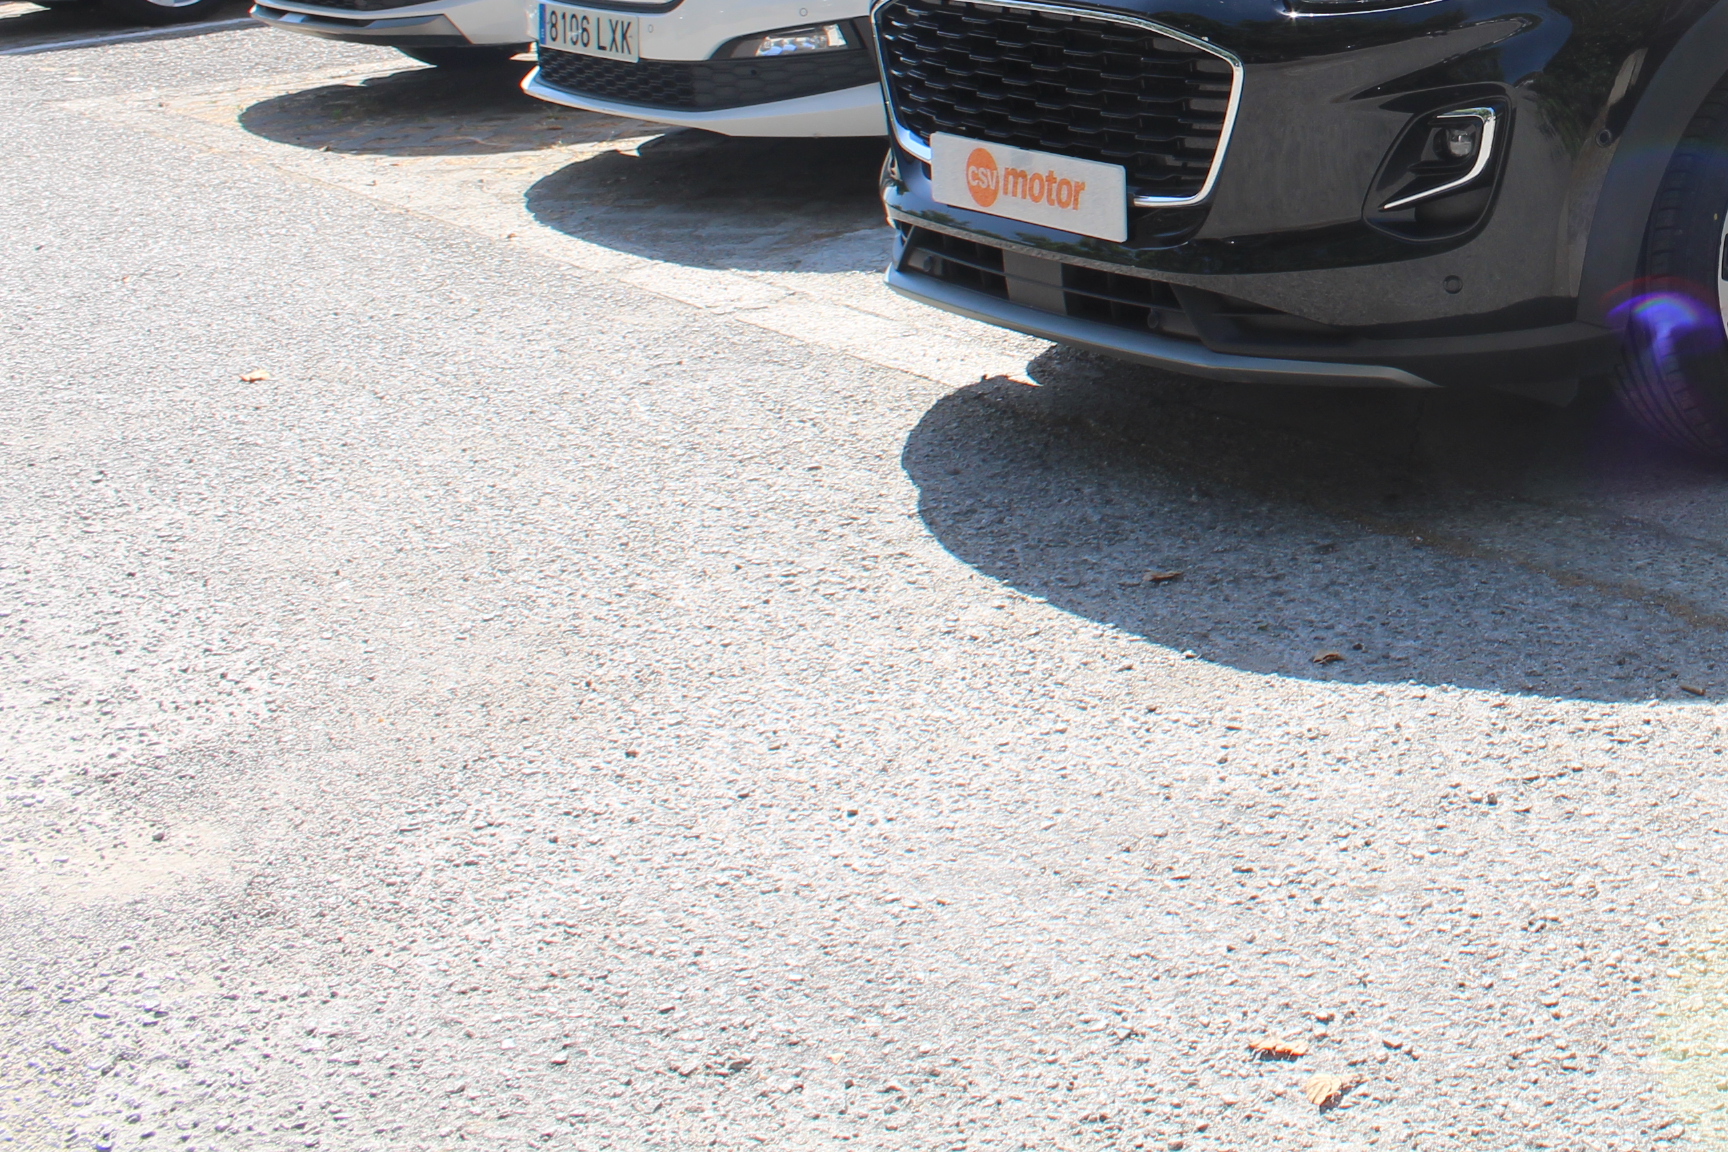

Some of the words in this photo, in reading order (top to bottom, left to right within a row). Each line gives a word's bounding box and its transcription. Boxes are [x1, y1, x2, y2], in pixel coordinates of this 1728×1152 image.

[549, 10, 591, 48] 8106
[597, 17, 632, 55] LXK
[1002, 166, 1087, 211] motor
